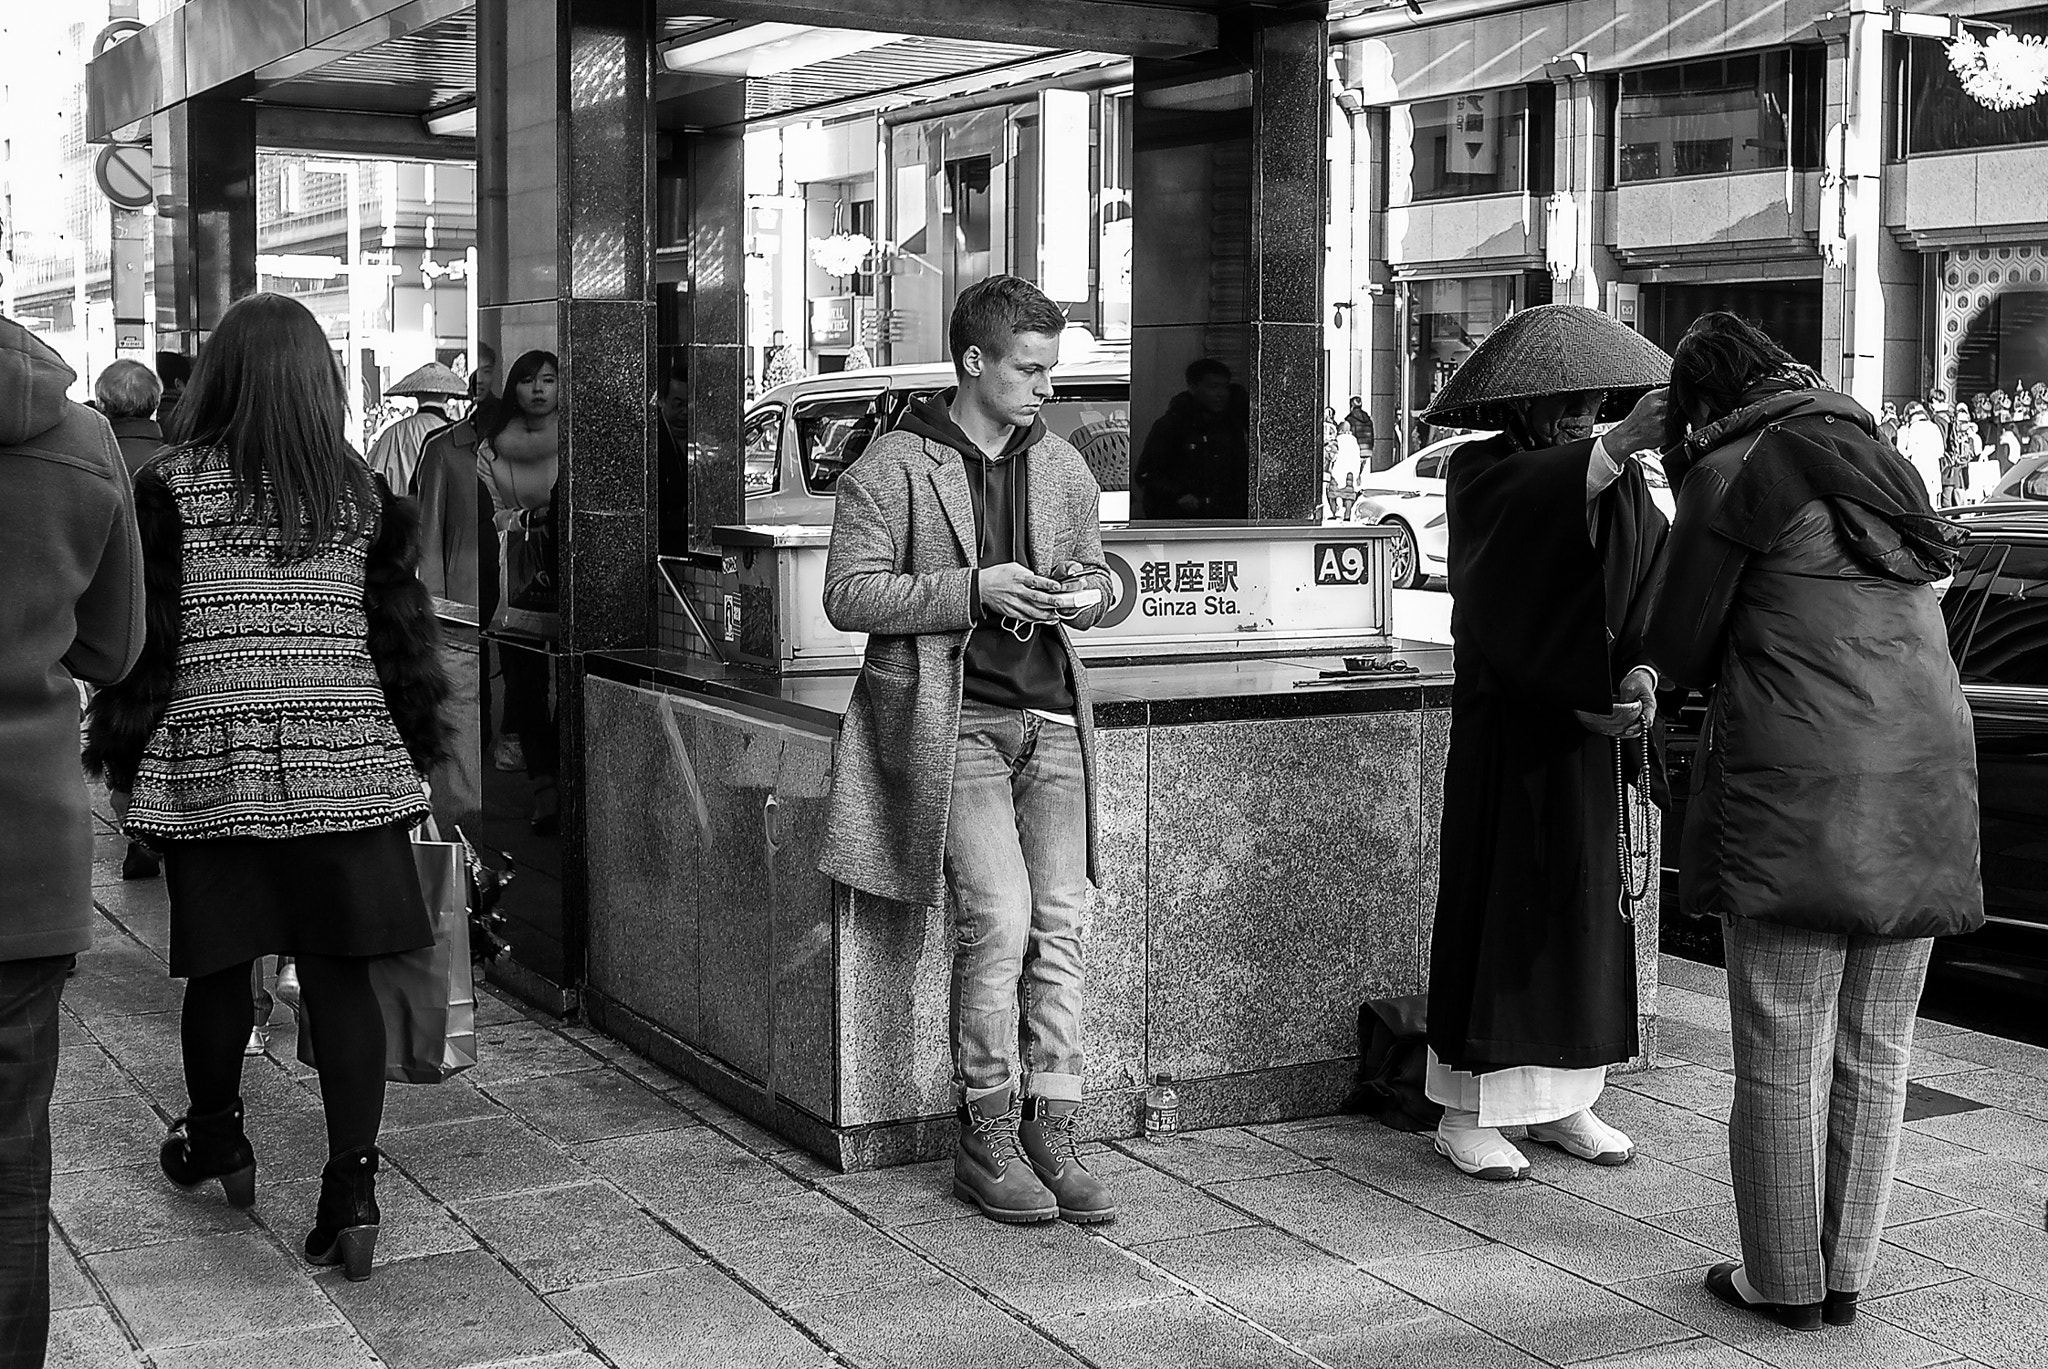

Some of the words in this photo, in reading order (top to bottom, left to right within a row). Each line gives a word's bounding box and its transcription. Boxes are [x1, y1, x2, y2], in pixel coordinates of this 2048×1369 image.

[1139, 560, 1239, 594] 銀座駅
[1318, 547, 1365, 581] A9
[1142, 597, 1197, 617] Ginza
[1204, 595, 1241, 615] Sta.
